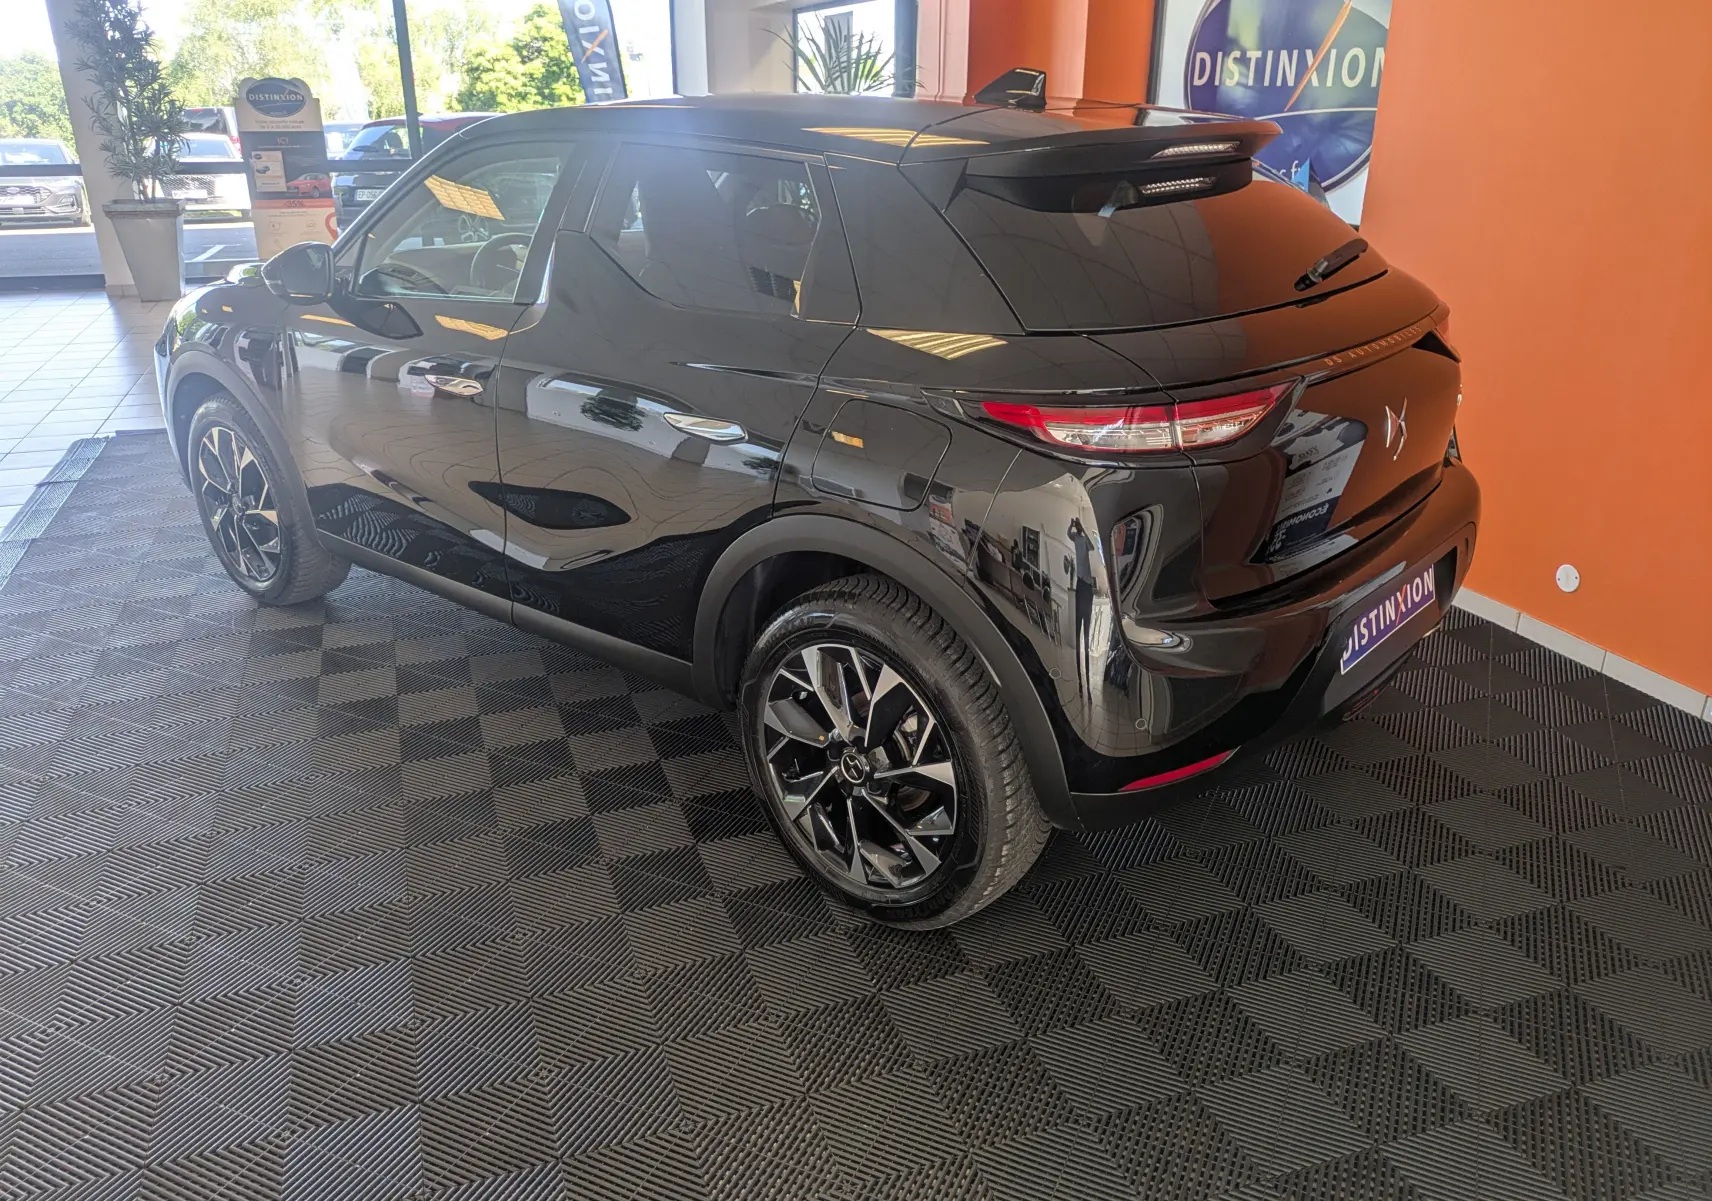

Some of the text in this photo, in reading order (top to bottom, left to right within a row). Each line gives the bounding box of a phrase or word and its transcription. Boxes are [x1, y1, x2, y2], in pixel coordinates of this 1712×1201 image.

[248, 92, 303, 101] DISTINXION
[1323, 324, 1423, 367] DS AUTOMOBILES
